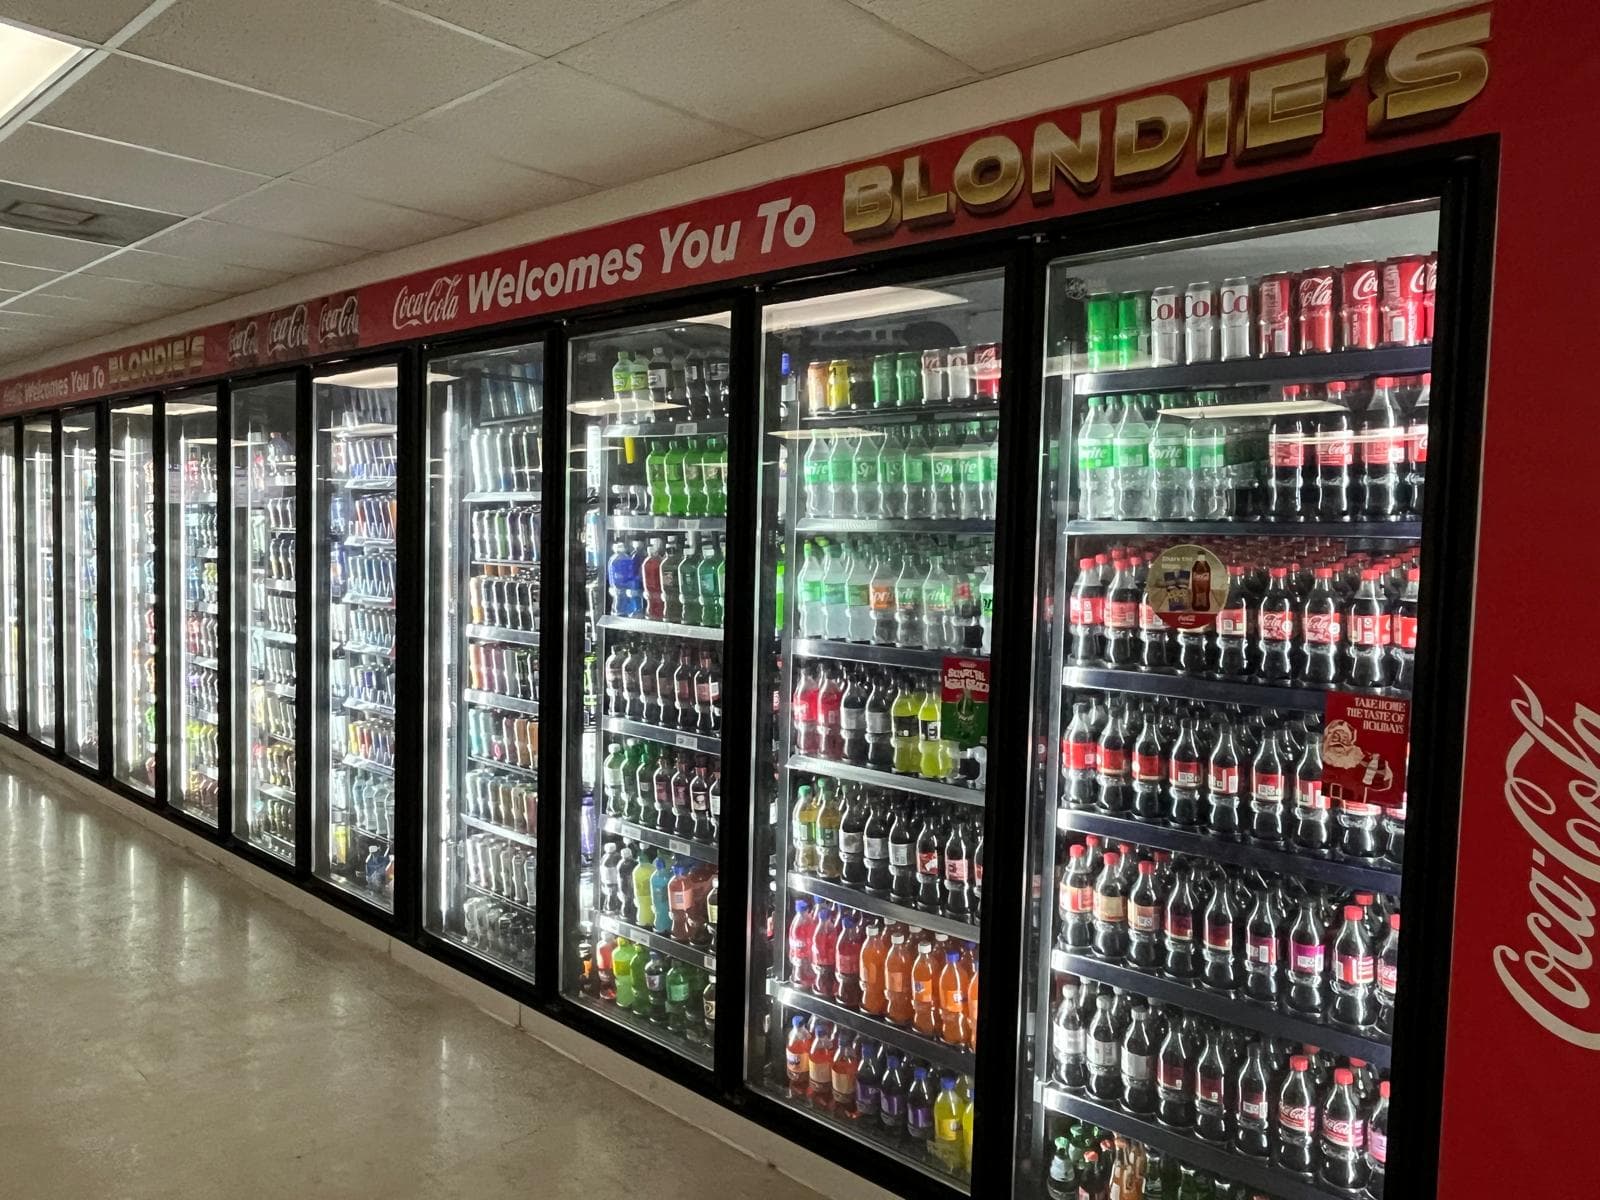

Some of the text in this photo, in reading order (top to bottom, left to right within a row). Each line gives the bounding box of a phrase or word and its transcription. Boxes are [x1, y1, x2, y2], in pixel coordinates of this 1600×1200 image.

[393, 12, 1492, 330] Coca-Cola Welcomes You To BLONDIE'S
[71, 370, 89, 393] You
[92, 366, 105, 389] To
[108, 335, 205, 384] BLONDIE'S
[1354, 697, 1406, 713] TAKE HOME
[1346, 707, 1406, 723] THE TASTE OF
[1363, 720, 1405, 734] HOLIDAYS
